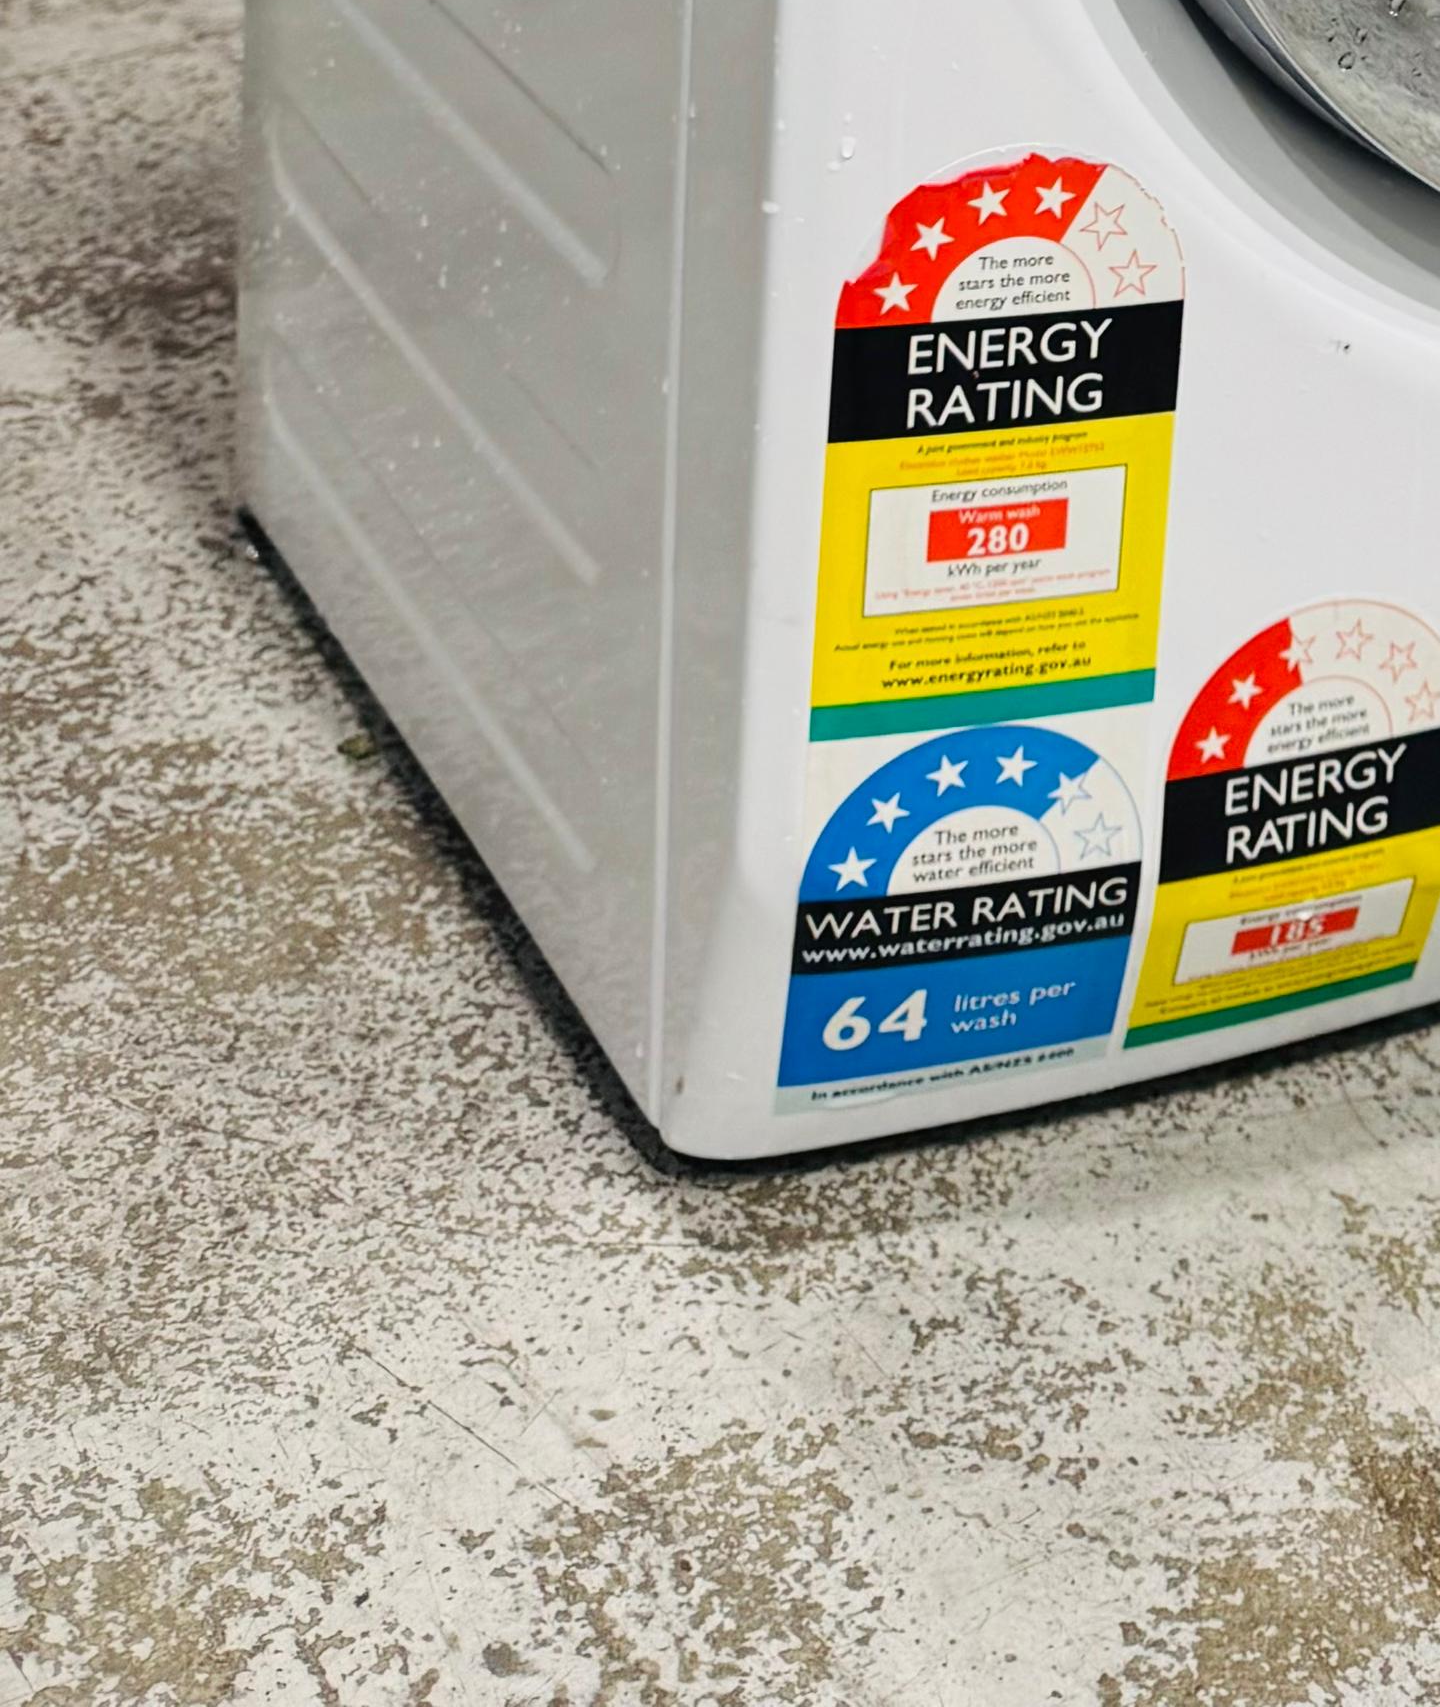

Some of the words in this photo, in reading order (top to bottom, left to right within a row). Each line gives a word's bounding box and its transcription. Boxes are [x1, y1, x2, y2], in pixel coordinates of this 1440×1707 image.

[979, 256, 1008, 272] The
[1012, 252, 1054, 268] more
[958, 277, 995, 293] stars
[1000, 273, 1025, 289] the
[1030, 270, 1071, 285] more
[955, 295, 1007, 312] energy
[1012, 287, 1071, 307] efficient
[907, 317, 1113, 376] ENERGY
[906, 372, 1104, 430] RATING
[931, 489, 977, 504] Energy
[982, 480, 1068, 498] consumption
[958, 508, 1004, 525] Warm
[1007, 504, 1041, 519] wash
[966, 522, 1029, 557] 280
[947, 564, 982, 578] kWh
[985, 562, 1010, 577] per
[1013, 558, 1042, 574] year
[889, 657, 912, 671] For
[915, 654, 951, 666] more
[955, 647, 1034, 664] information,
[1038, 641, 1067, 656] refer
[1071, 639, 1086, 650] to
[882, 655, 1092, 689] www.energyrating.gov.au
[1287, 702, 1315, 718] The
[1319, 695, 1355, 712] more
[1267, 737, 1313, 755] energy
[1317, 723, 1370, 746] efficient
[1270, 722, 1301, 737] stars
[1306, 717, 1329, 732] the
[1333, 710, 1368, 726] more
[1224, 742, 1408, 817] ENERGY
[934, 829, 968, 847] The
[972, 824, 1019, 842] more
[1225, 795, 1390, 865] RATING
[911, 849, 953, 867] stars
[959, 843, 988, 861] the
[992, 839, 1038, 857] more
[912, 865, 961, 884] water
[968, 856, 1035, 878] efficient
[804, 901, 958, 941] WATER
[971, 877, 1129, 926] RATING
[801, 912, 1125, 964] www.waterrating.gov.au
[953, 991, 1021, 1014] litres
[1028, 981, 1075, 1007] per
[822, 989, 928, 1051] 64
[951, 1010, 1018, 1035] wash
[811, 1090, 829, 1102] In
[832, 1075, 925, 1100] accordance
[929, 1066, 966, 1083] with
